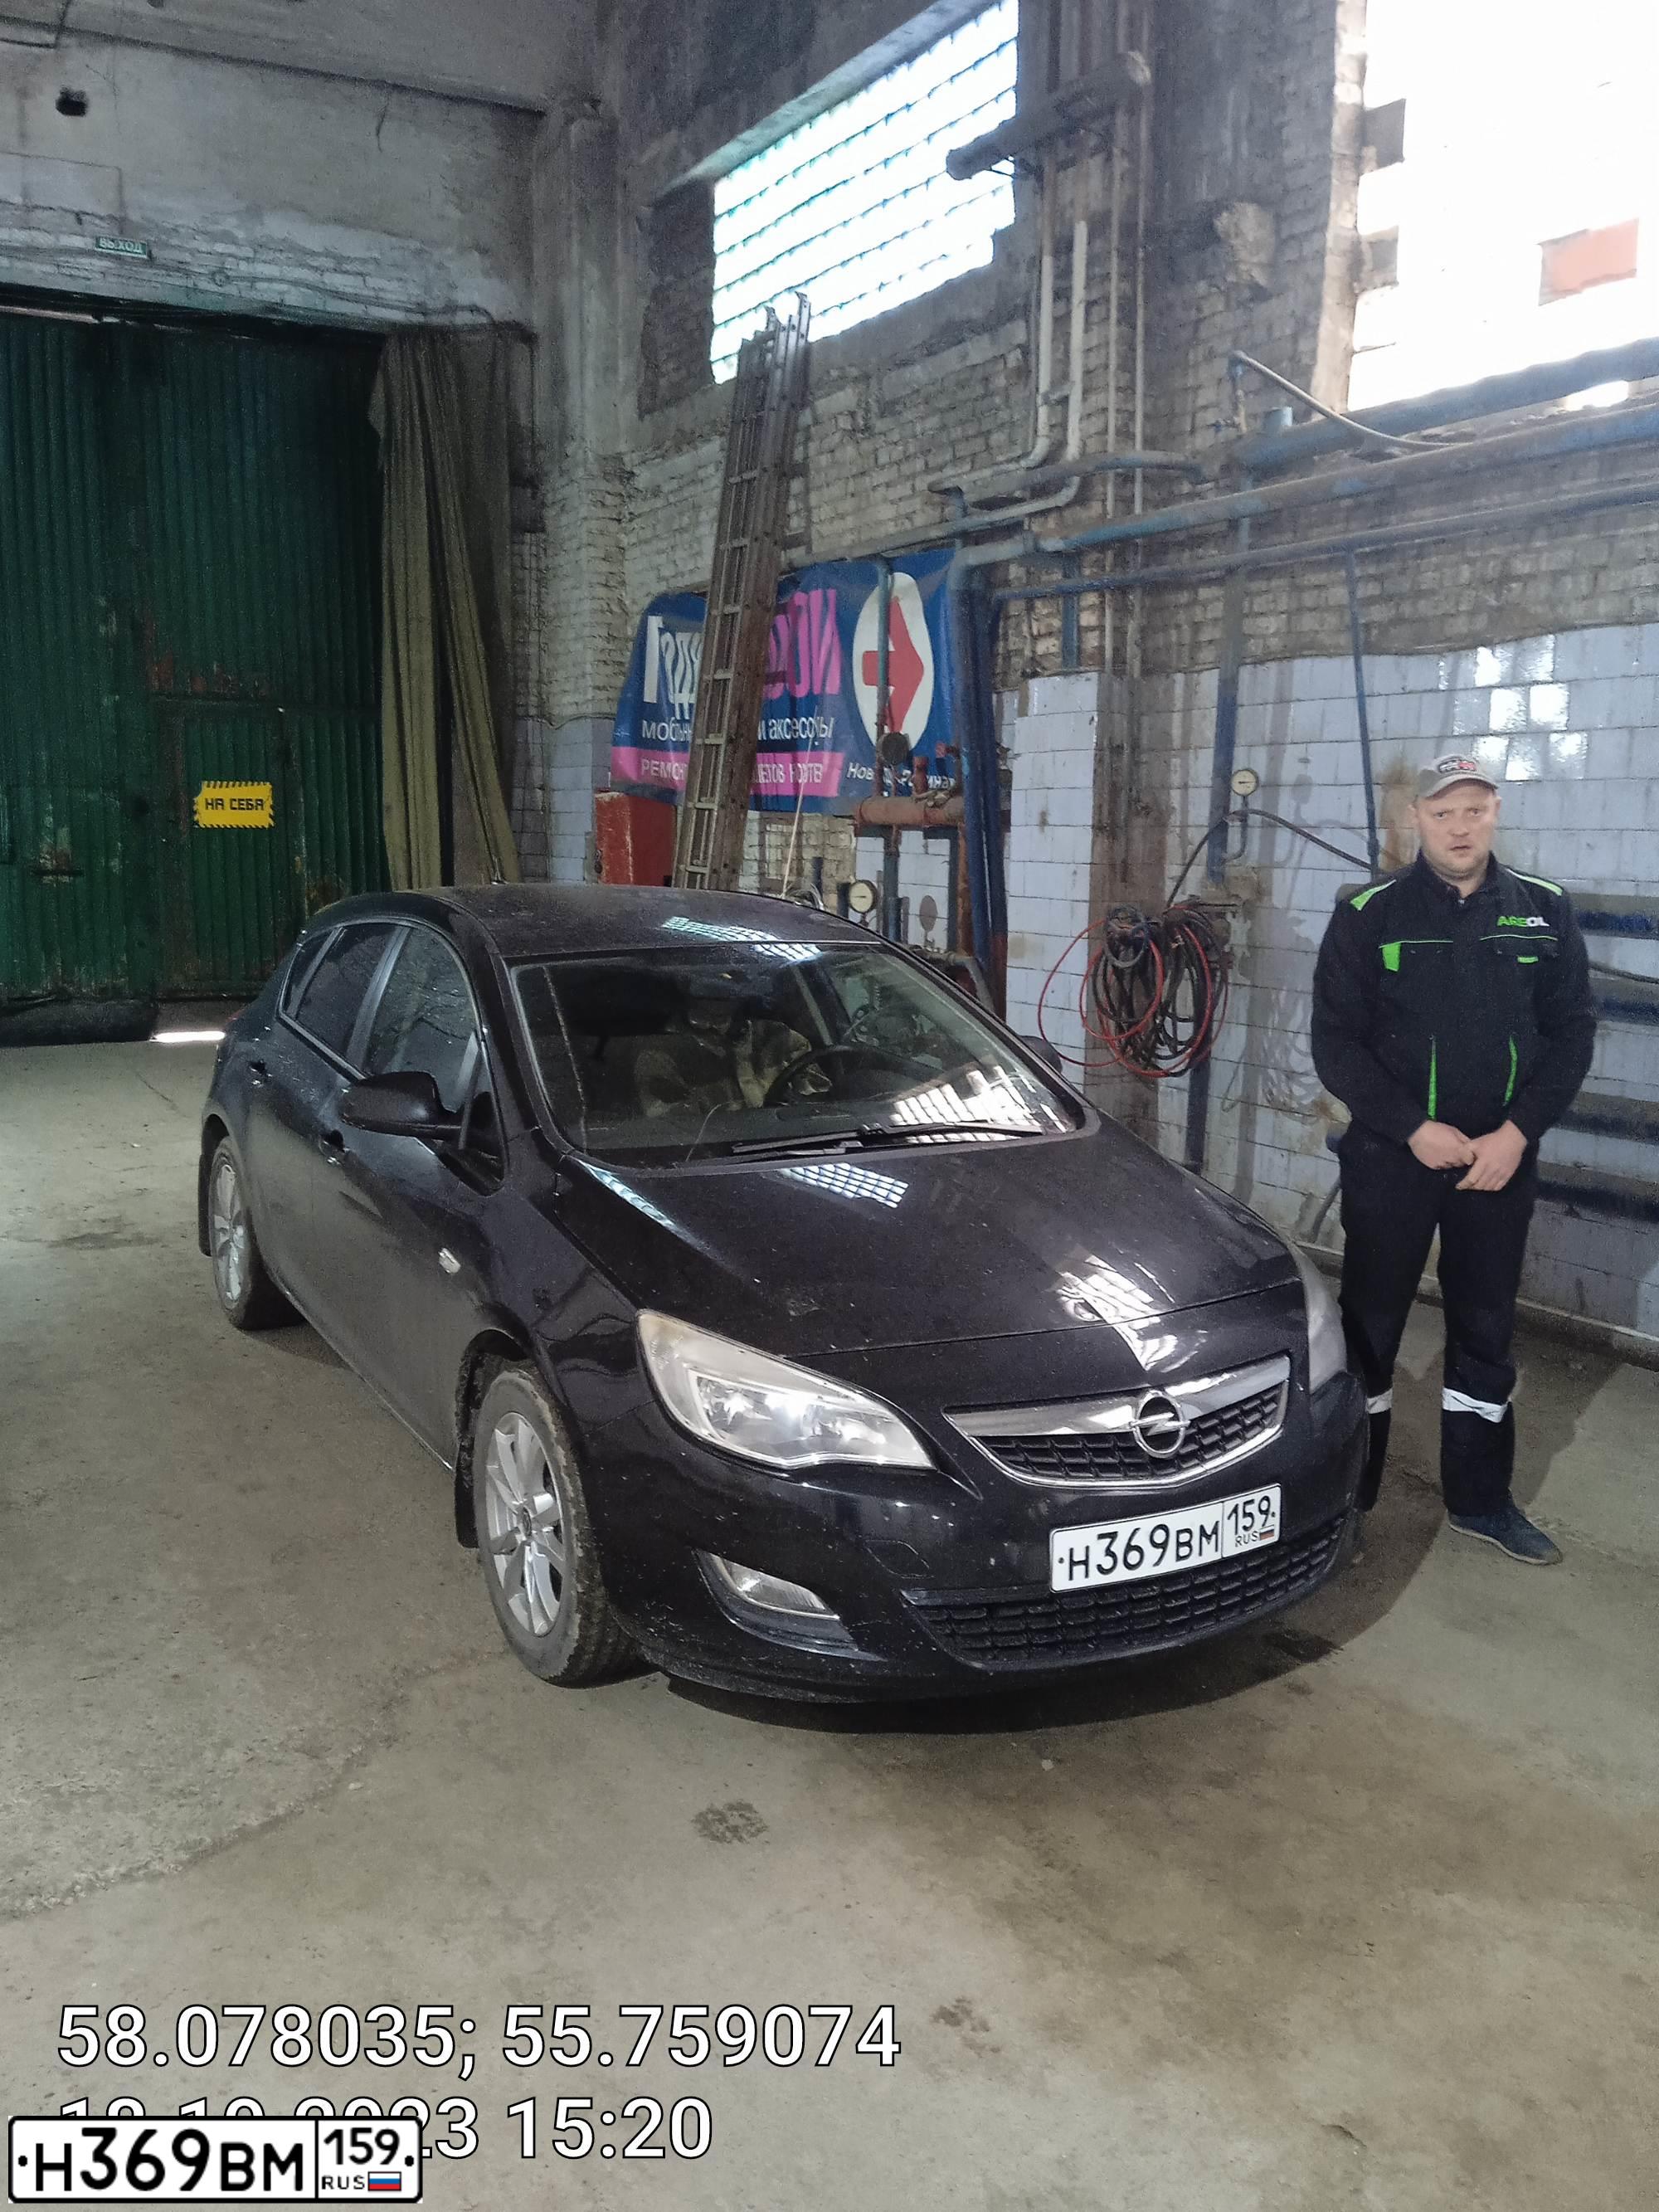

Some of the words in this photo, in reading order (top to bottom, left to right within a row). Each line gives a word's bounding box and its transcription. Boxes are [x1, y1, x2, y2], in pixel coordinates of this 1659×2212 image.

[100, 237, 142, 253] ВЫХОД
[205, 798, 224, 810] НА
[1227, 1495, 1272, 1535] 159
[1234, 1530, 1260, 1547] RUS
